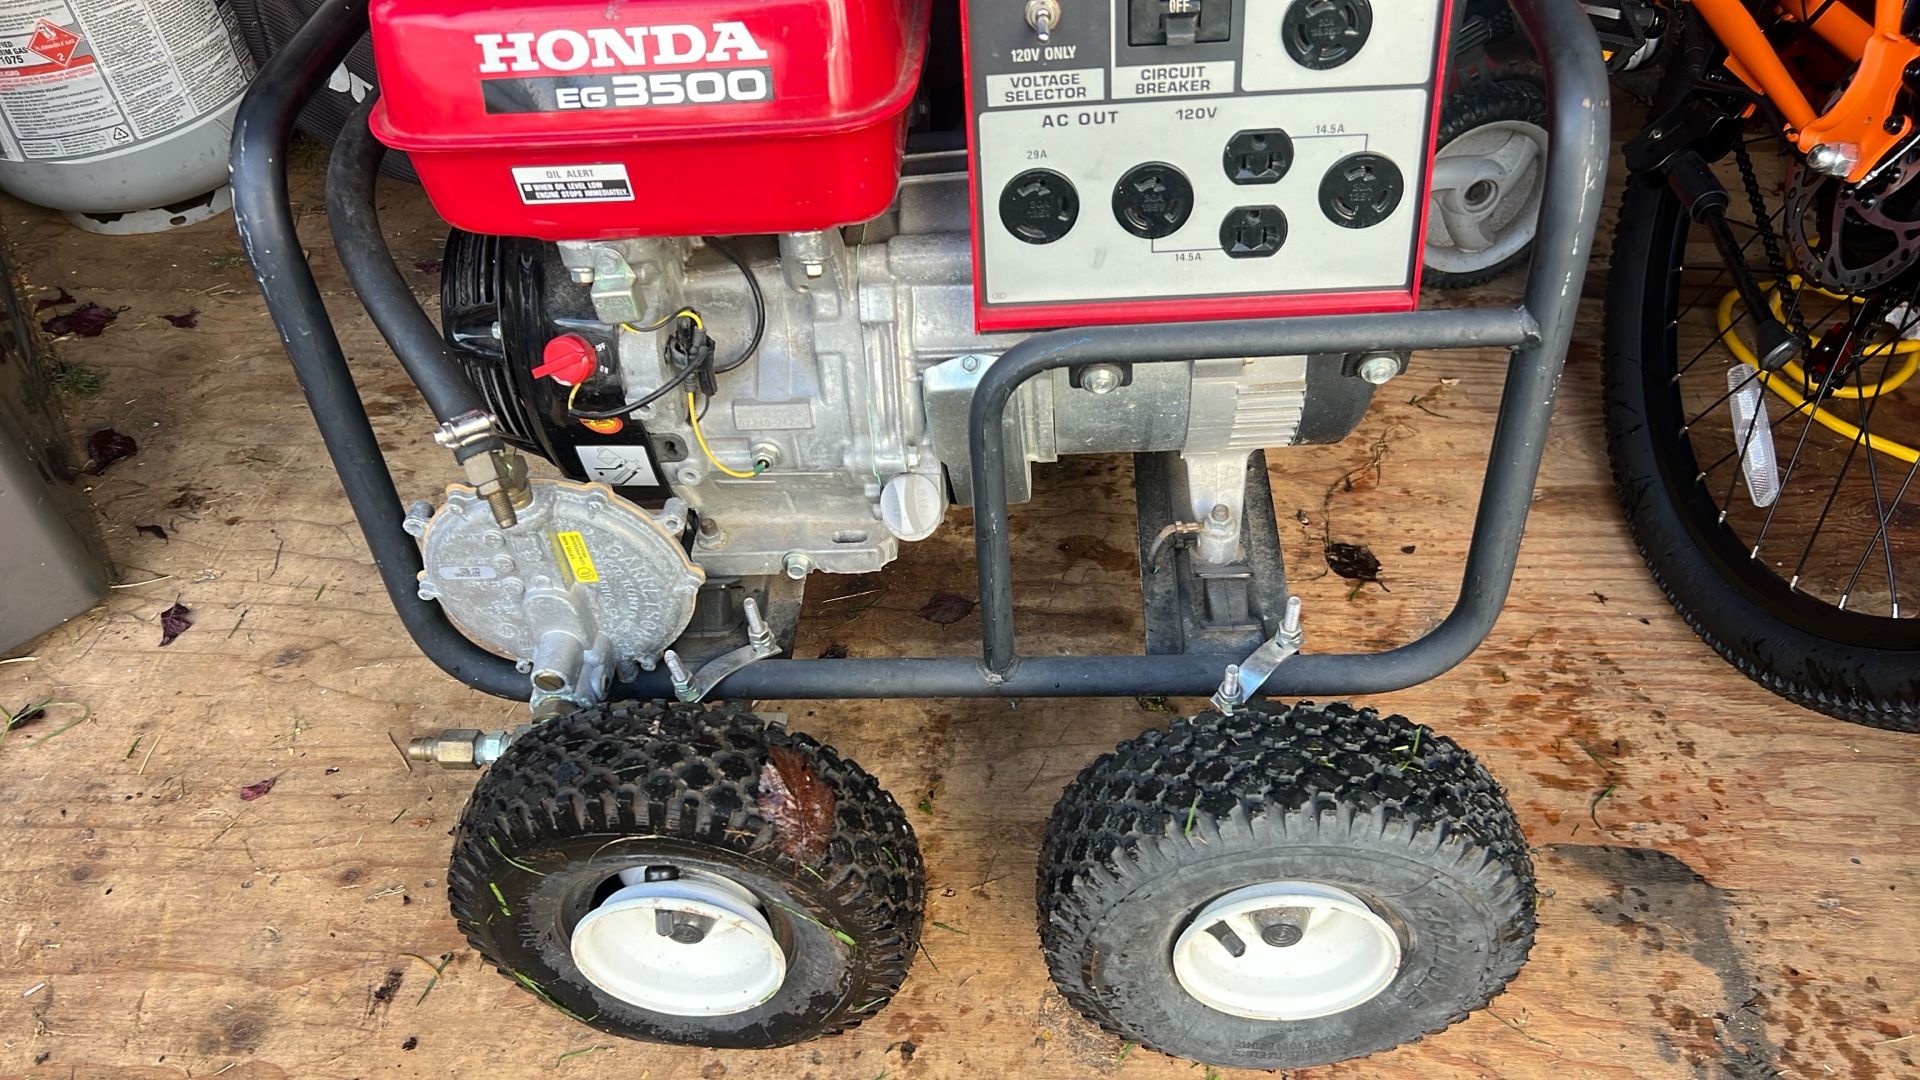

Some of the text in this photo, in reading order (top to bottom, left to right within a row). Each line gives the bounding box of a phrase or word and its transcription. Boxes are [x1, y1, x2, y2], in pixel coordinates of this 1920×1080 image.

[1169, 0, 1190, 13] OFF
[13, 46, 28, 54] GAS
[474, 21, 769, 73] HONDA
[0, 55, 24, 65] 1075
[56, 53, 65, 61] 2
[1010, 46, 1077, 63] 120V ONLY
[1141, 66, 1206, 81] CIRCUIT
[1010, 73, 1080, 89] VOLTAGE
[1135, 79, 1211, 95] BREAKER
[1005, 87, 1087, 103] SELECTOR
[1042, 111, 1119, 128] AC OUT
[1175, 107, 1218, 121] 120V
[1316, 124, 1345, 134] 14.5A
[1027, 150, 1048, 160] 29A
[545, 169, 595, 179] OIL ALERT
[532, 181, 604, 191] WHEN OIL LEVEL LOW
[535, 191, 561, 199] ENGINE
[560, 190, 584, 198] STOPS
[1175, 252, 1202, 262] 14.5A
